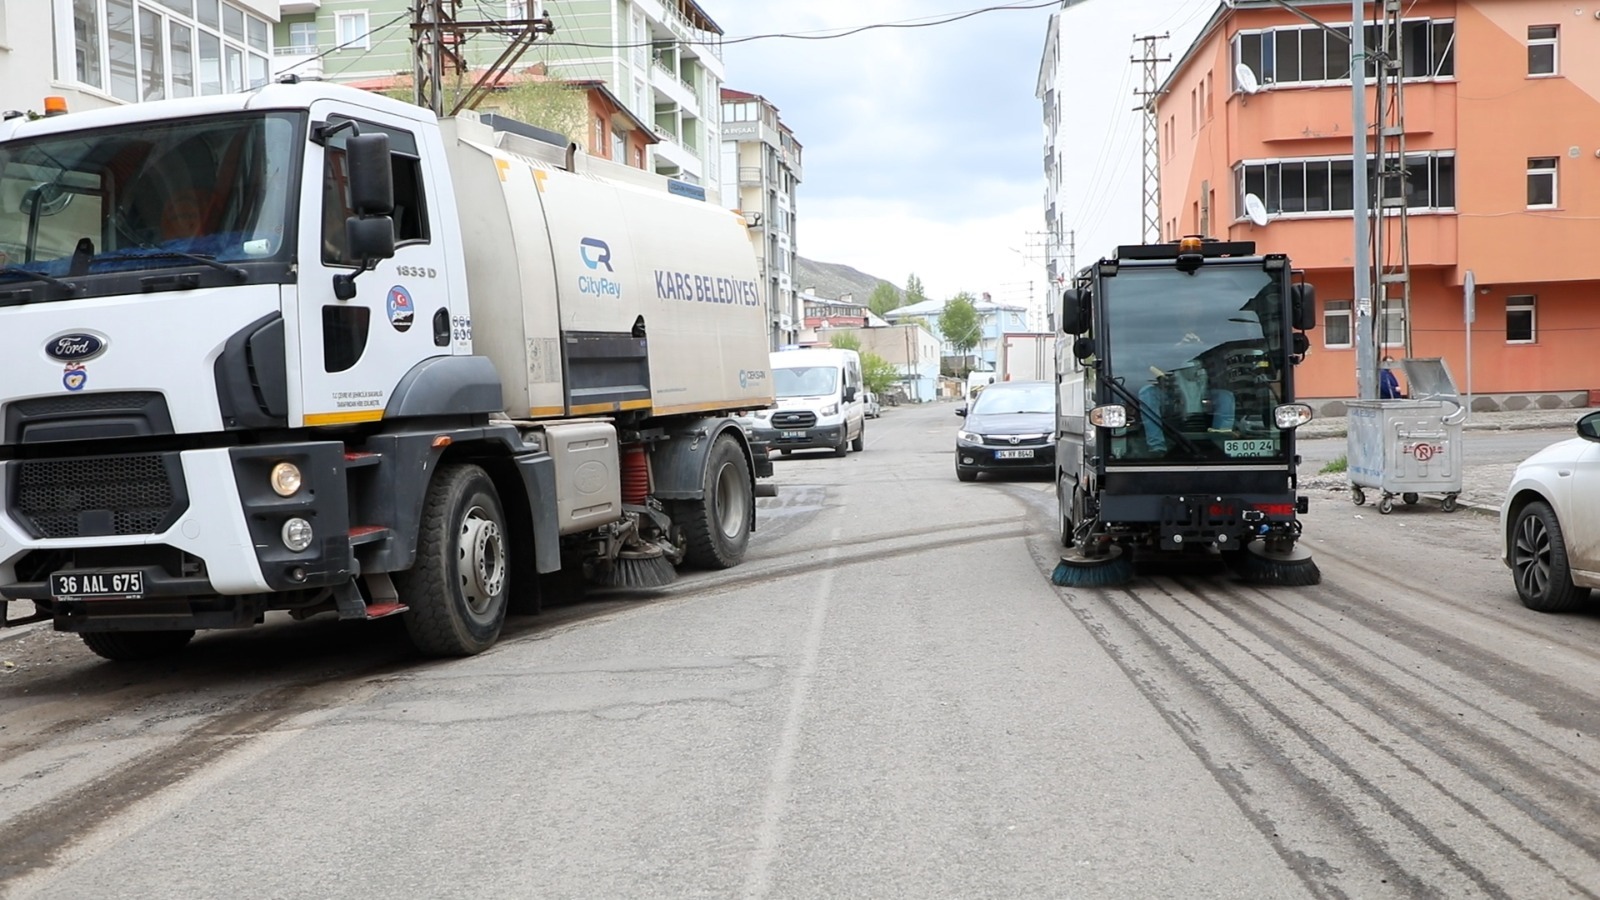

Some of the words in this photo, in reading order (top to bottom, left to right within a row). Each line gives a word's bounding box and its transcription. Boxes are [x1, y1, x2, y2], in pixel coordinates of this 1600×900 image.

[396, 264, 426, 278] 1833
[427, 268, 437, 279] D
[578, 275, 621, 299] CityRay
[654, 270, 693, 302] KARS
[694, 275, 760, 307] BELEDİYESİ
[55, 336, 89, 355] Ford
[1226, 442, 1239, 451] 36
[1242, 441, 1255, 451] 00
[1259, 441, 1272, 450] 24
[59, 576, 77, 593] 36
[83, 575, 109, 593] AAL
[112, 573, 140, 592] 675
